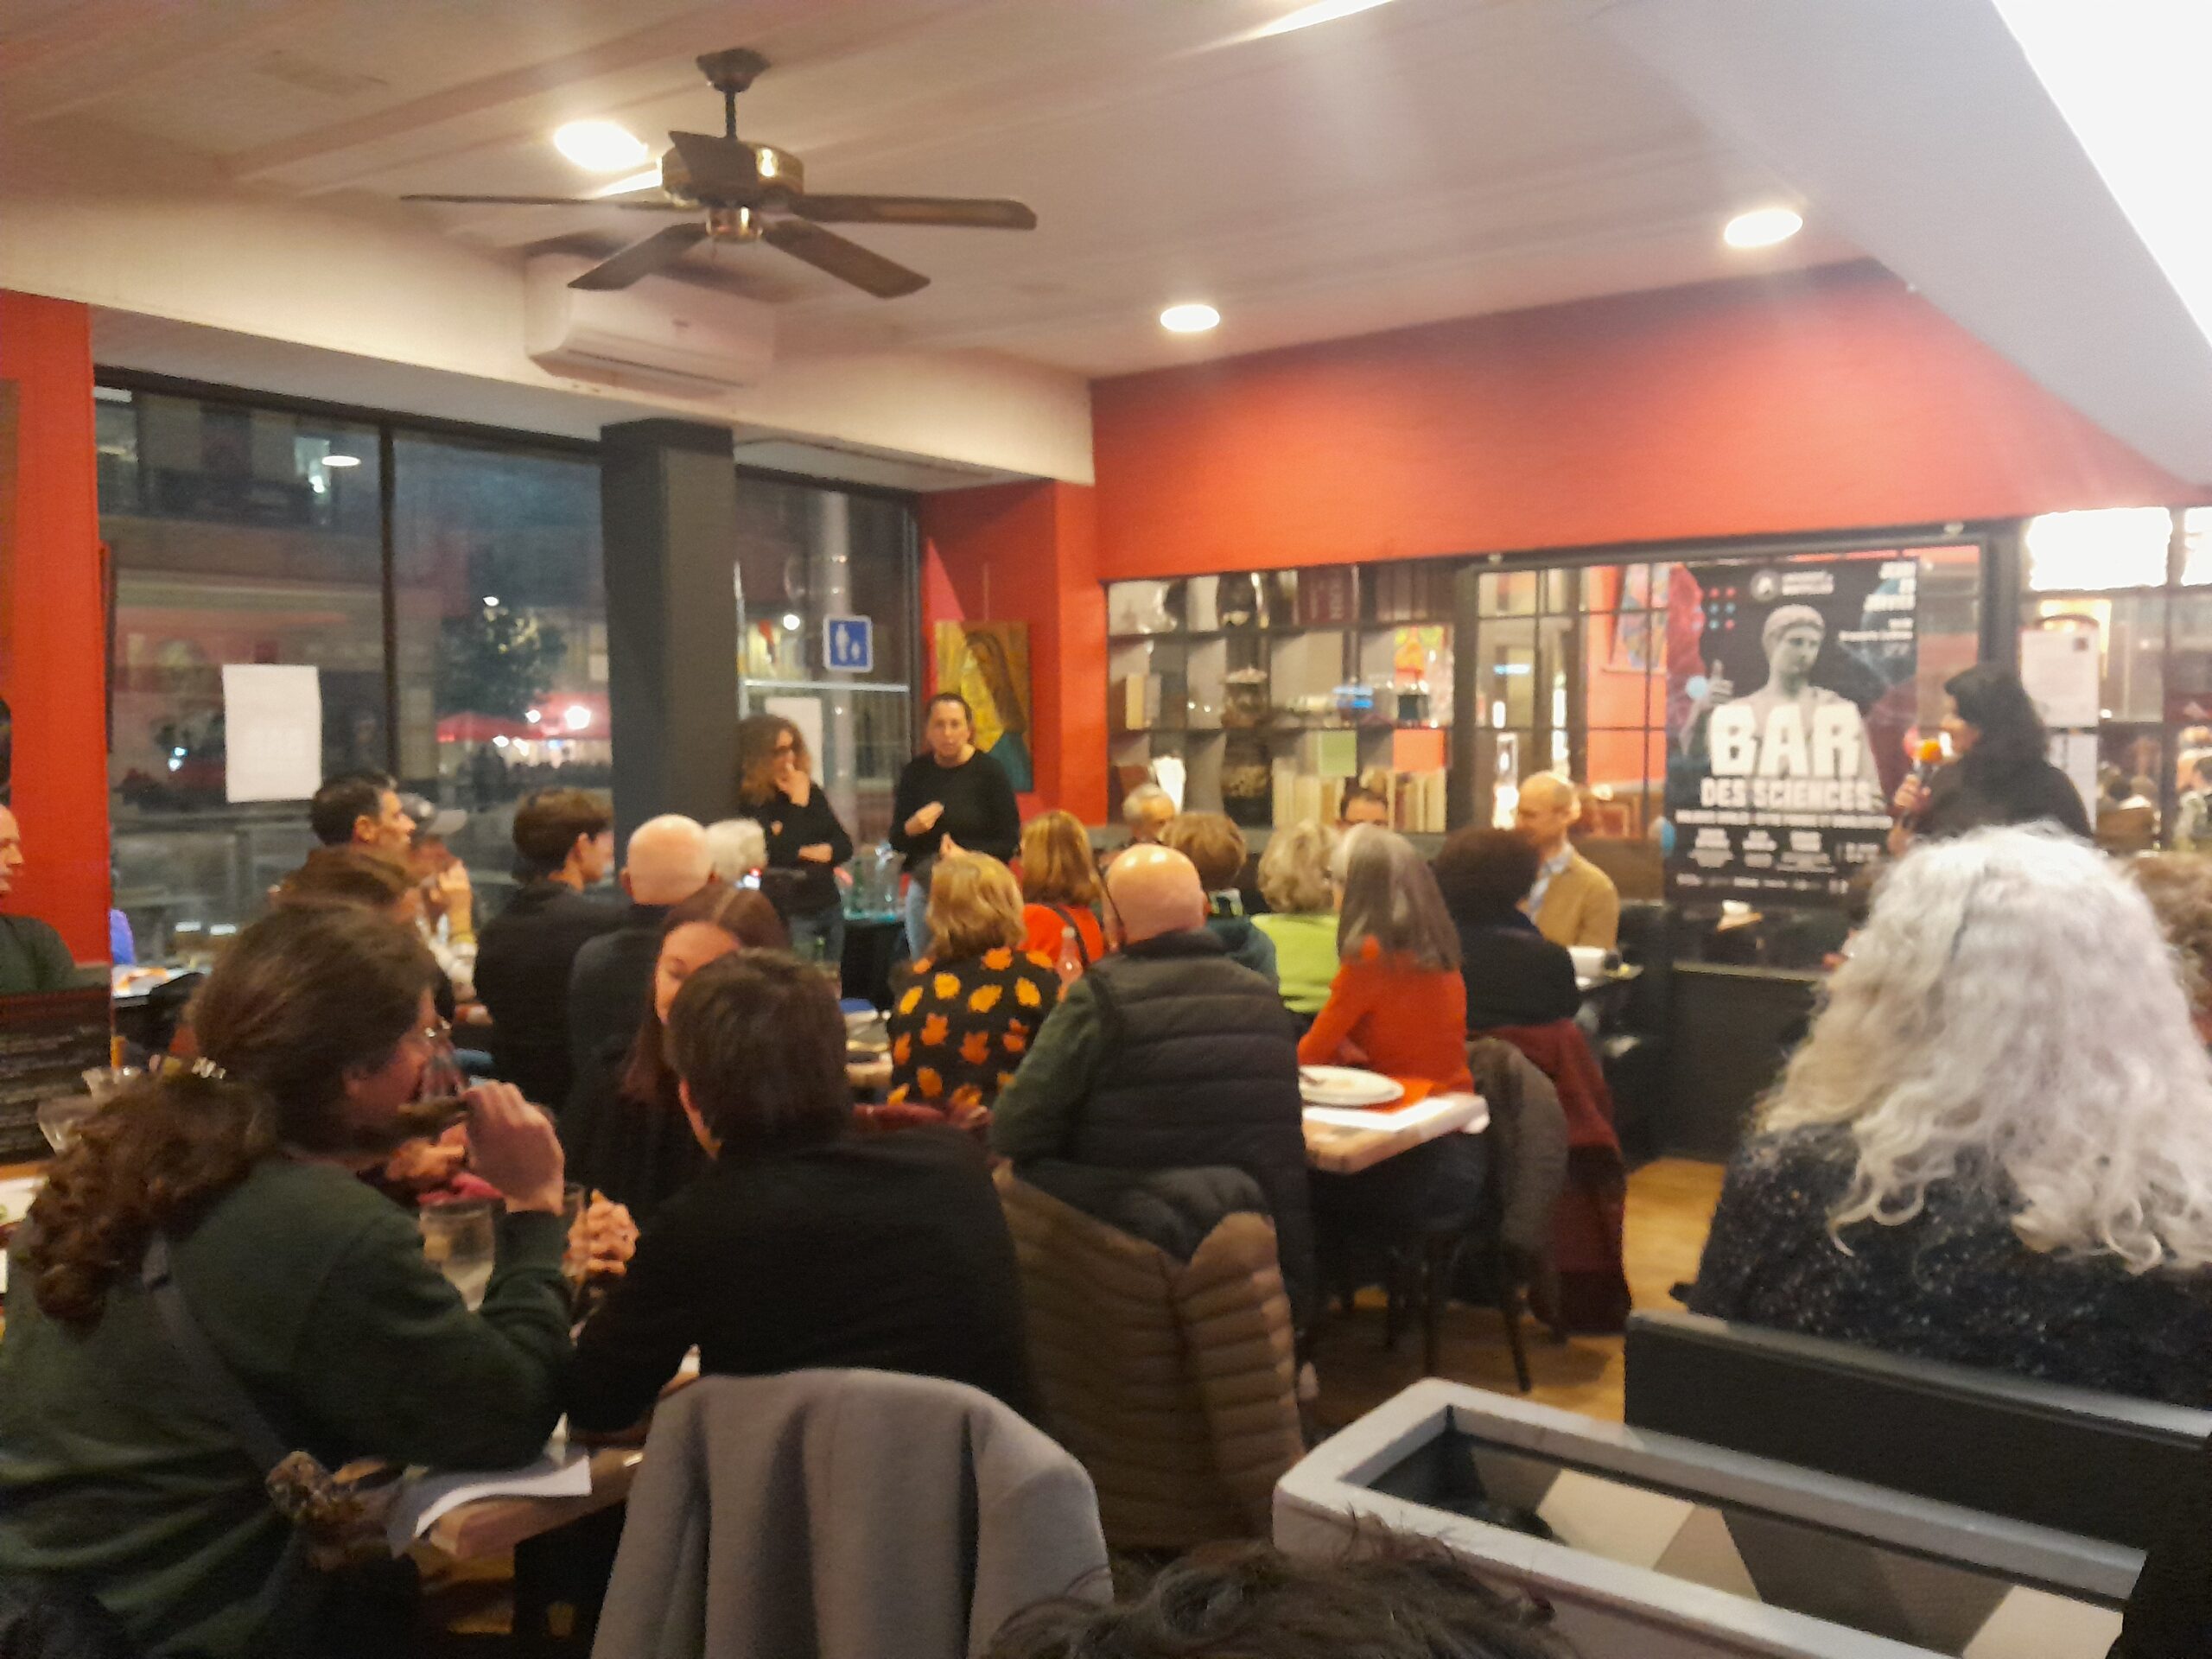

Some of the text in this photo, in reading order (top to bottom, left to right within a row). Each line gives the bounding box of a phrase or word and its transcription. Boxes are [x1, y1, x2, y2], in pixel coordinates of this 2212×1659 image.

[1709, 702, 1861, 777] BAR
[1700, 777, 1871, 811] DES SCIENCES
